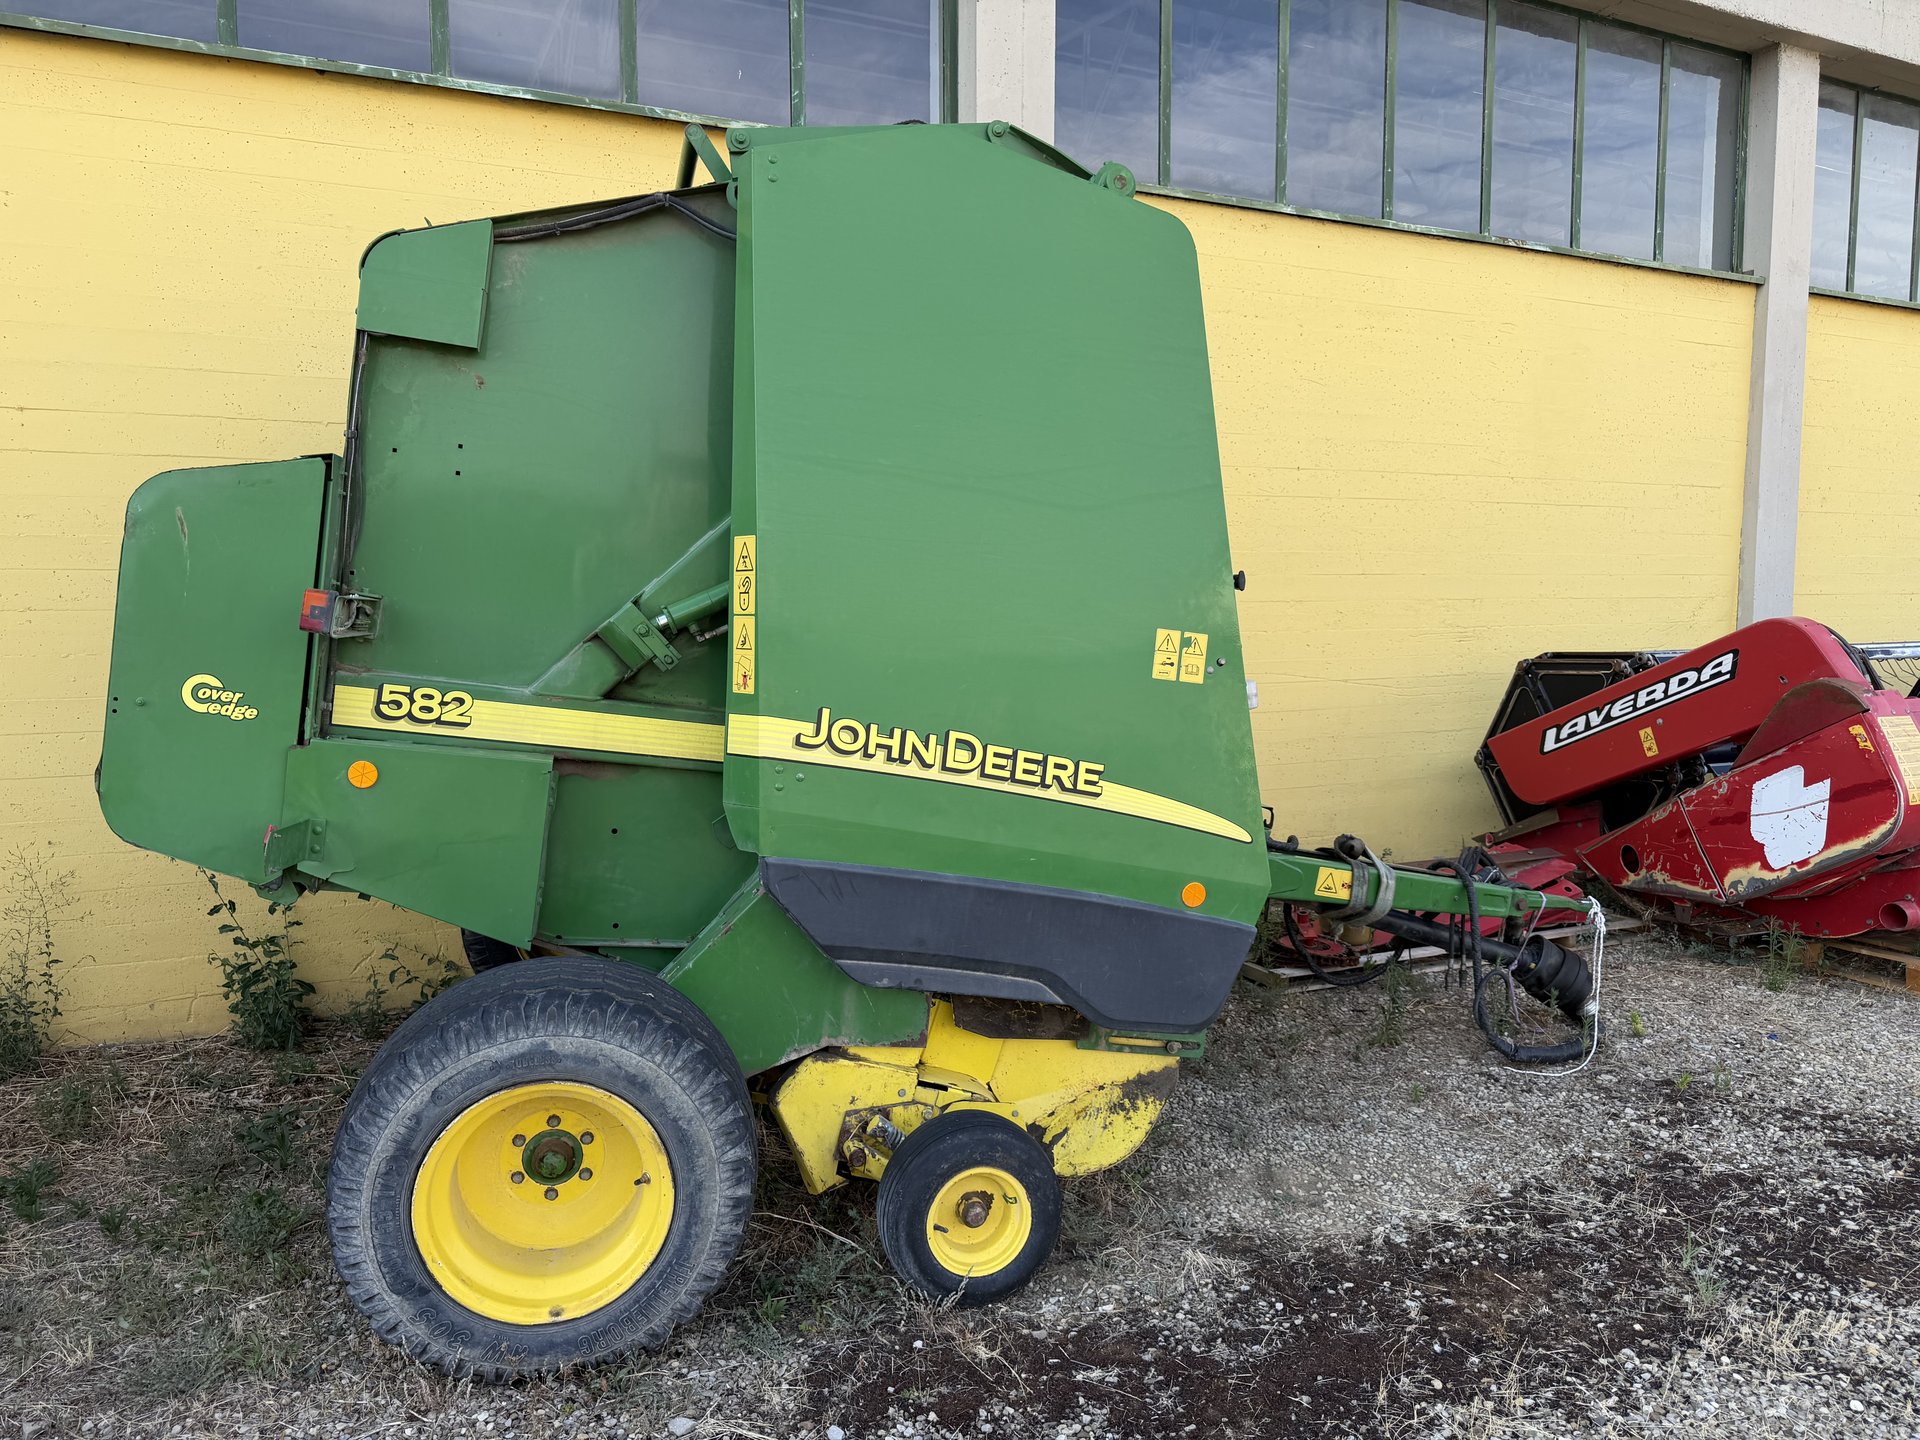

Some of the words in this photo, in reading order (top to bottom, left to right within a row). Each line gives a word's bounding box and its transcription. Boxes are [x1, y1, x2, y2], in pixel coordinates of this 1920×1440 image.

[181, 673, 244, 714] Cover
[207, 702, 259, 721] edge
[375, 683, 474, 727] 582
[1543, 653, 1734, 752] LAVERDA
[796, 707, 938, 769] JOHN
[942, 730, 1105, 799] DEERE
[408, 1308, 472, 1351] 305
[577, 1259, 696, 1357] TRELLEBORG
